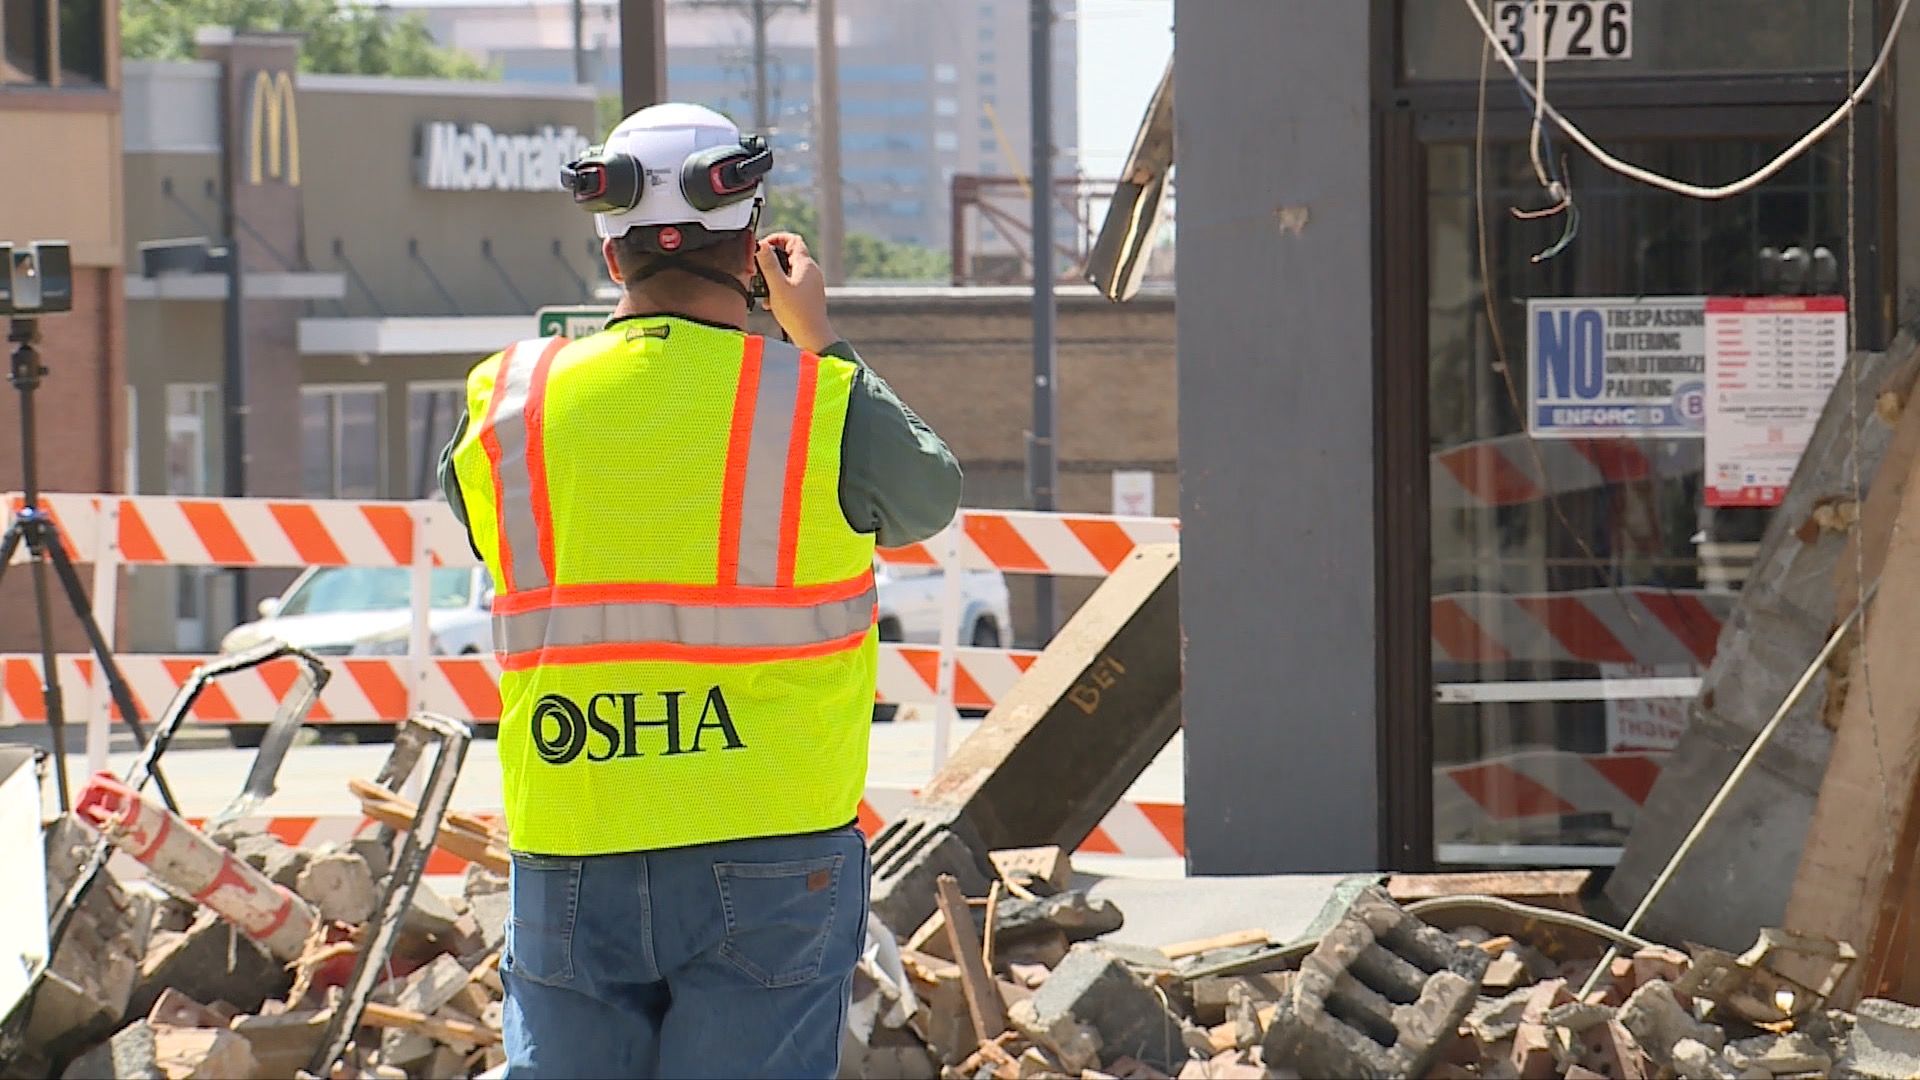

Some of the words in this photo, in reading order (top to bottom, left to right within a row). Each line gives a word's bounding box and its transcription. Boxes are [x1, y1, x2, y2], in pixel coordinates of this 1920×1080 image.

[1500, 3, 1627, 56] 3726
[1538, 309, 1603, 399] NO
[1606, 332, 1681, 351] LOITERING
[1605, 379, 1672, 398] PARKING
[532, 685, 747, 765] OSHA
